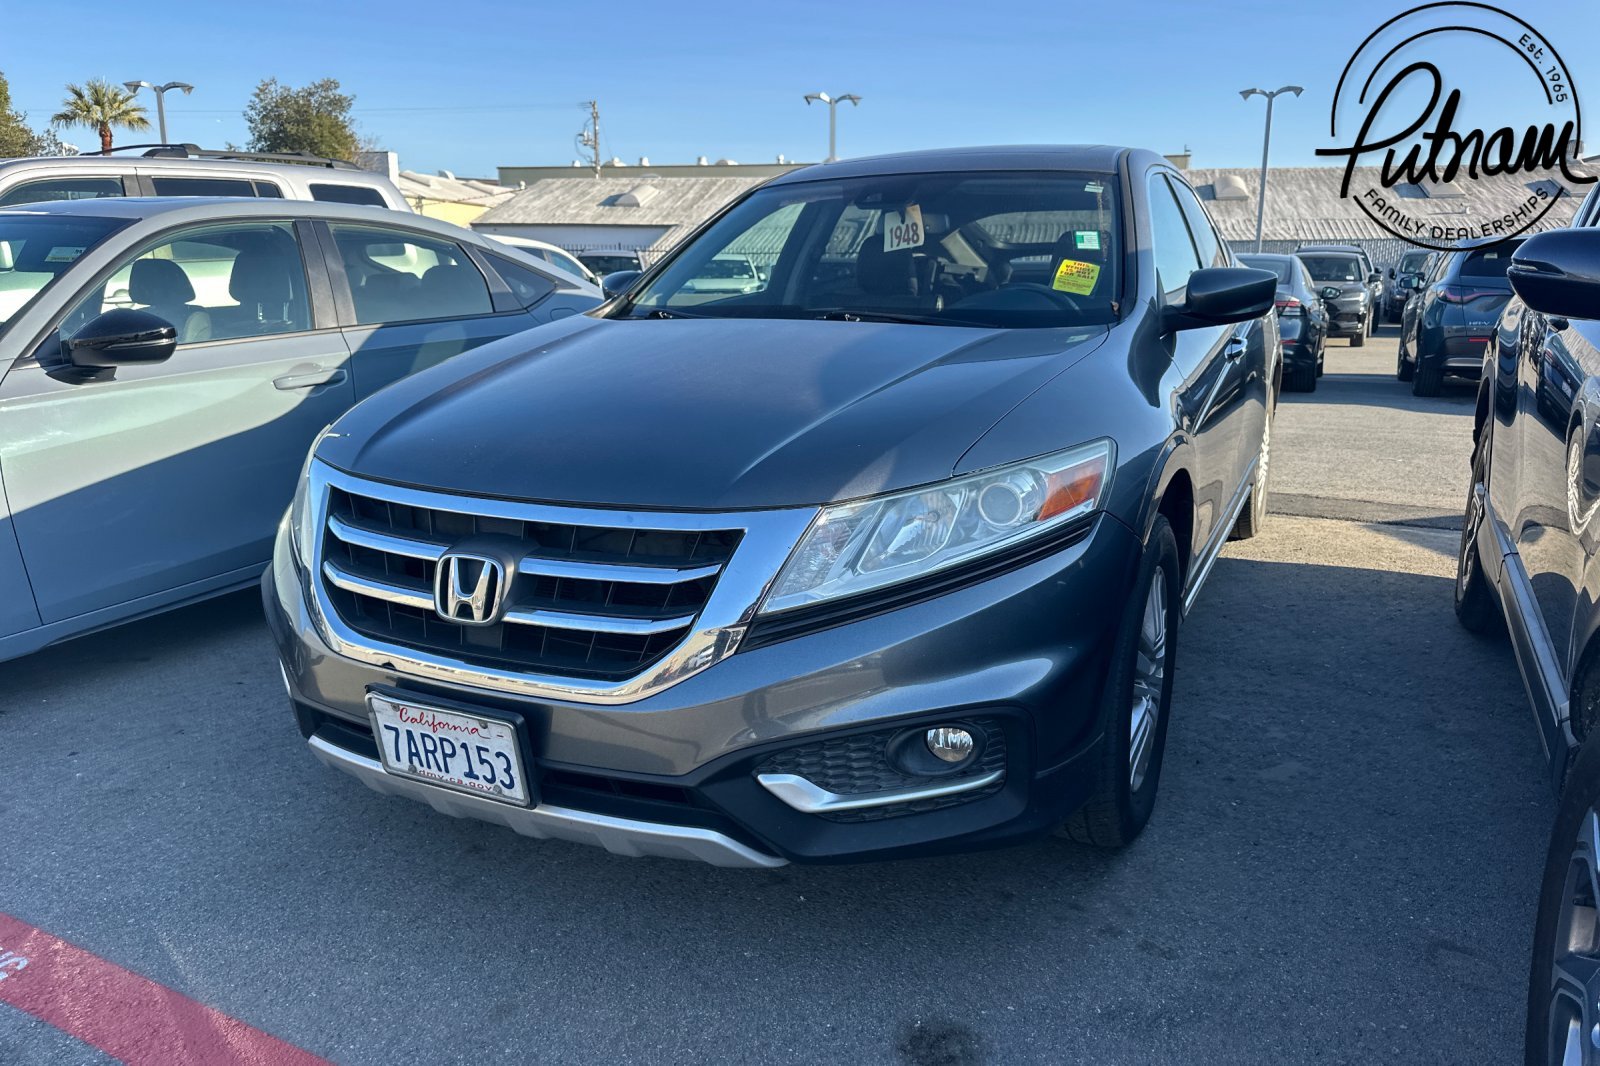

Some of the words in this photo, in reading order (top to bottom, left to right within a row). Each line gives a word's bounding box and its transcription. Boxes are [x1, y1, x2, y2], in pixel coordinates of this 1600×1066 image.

[890, 222, 919, 248] 1948
[399, 706, 491, 740] California
[383, 723, 515, 790] 7ARP153
